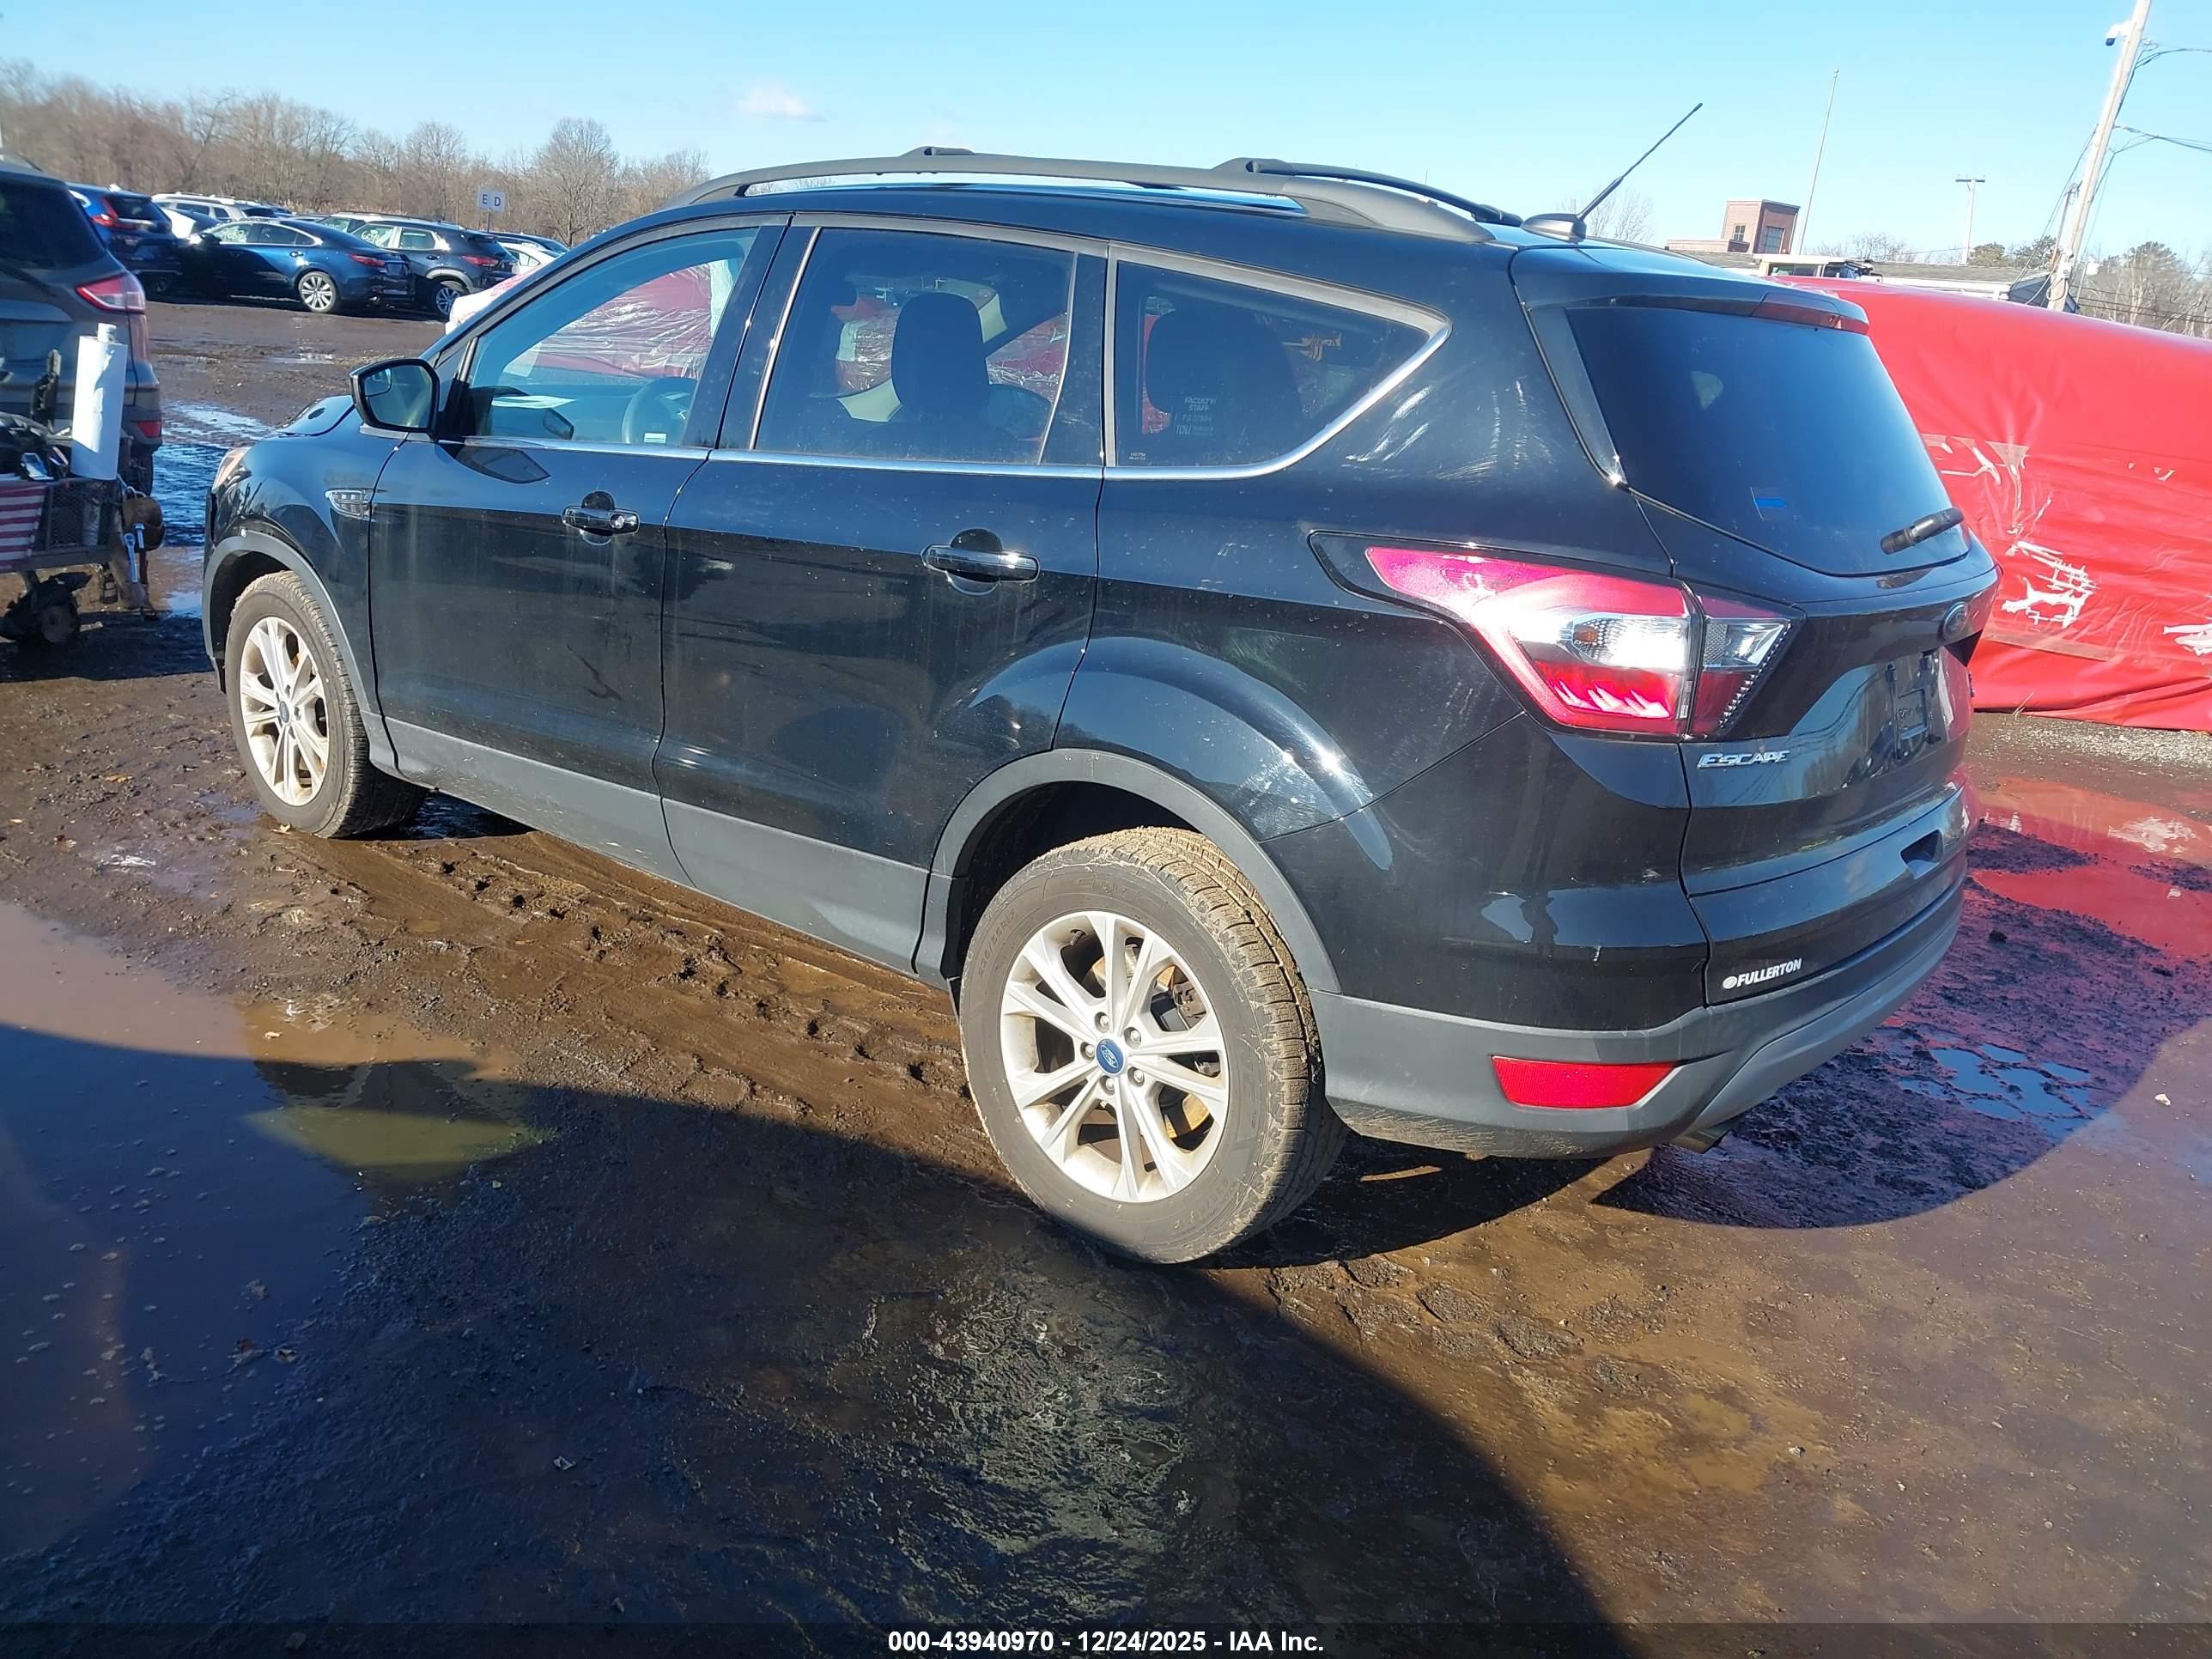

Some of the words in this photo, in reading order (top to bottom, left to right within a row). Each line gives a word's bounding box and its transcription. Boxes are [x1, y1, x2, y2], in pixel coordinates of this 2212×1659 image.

[482, 193, 488, 205] E
[494, 196, 501, 207] D
[1697, 750, 1790, 769] ESCAPE
[1736, 957, 1802, 988] FULLERTON
